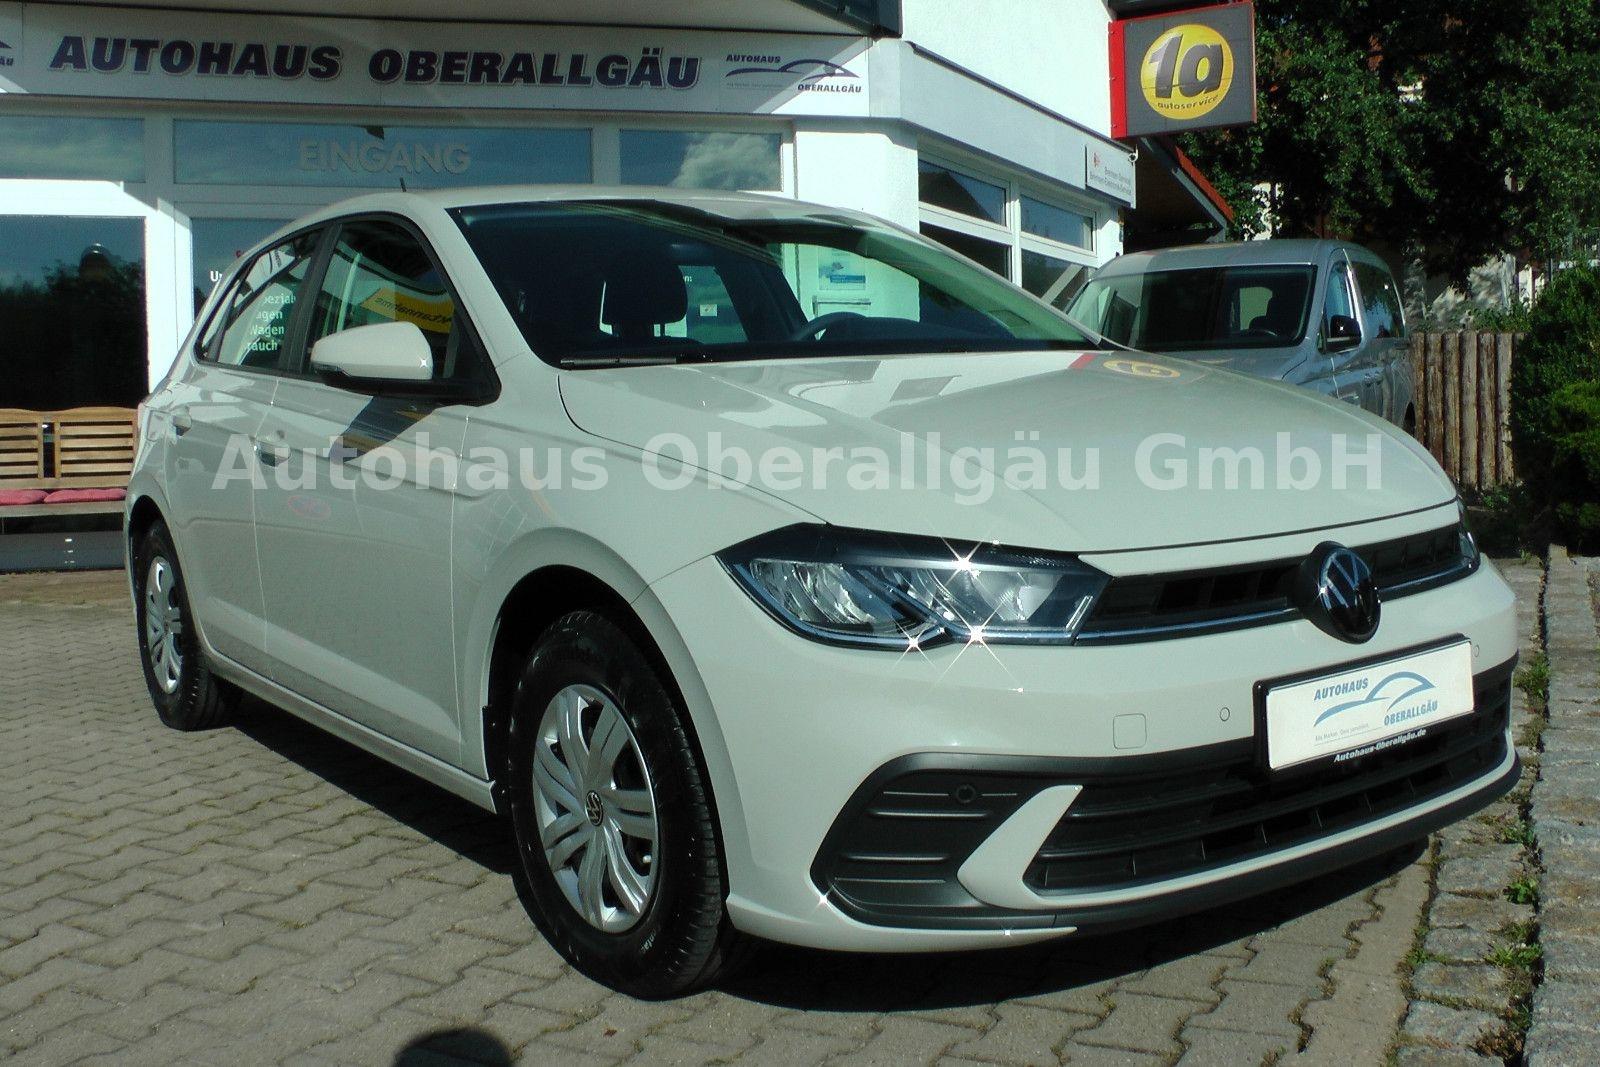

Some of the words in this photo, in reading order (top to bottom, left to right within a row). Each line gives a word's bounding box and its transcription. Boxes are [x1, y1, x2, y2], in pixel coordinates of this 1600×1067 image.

[49, 36, 342, 80] AUTOHAUS
[368, 47, 701, 88] OBERALLGÄU
[725, 54, 781, 64] AUTOHAUS
[1149, 34, 1224, 98] 1a
[798, 83, 862, 93] OBERALLGÄU
[1157, 94, 1219, 110] autoservice
[303, 139, 471, 175] EINGANG
[1314, 677, 1369, 700] AUTOHAUS
[1384, 700, 1438, 726] OBERALLGÄU
[1333, 728, 1427, 762] Autohaus-Oberallgäu.de
